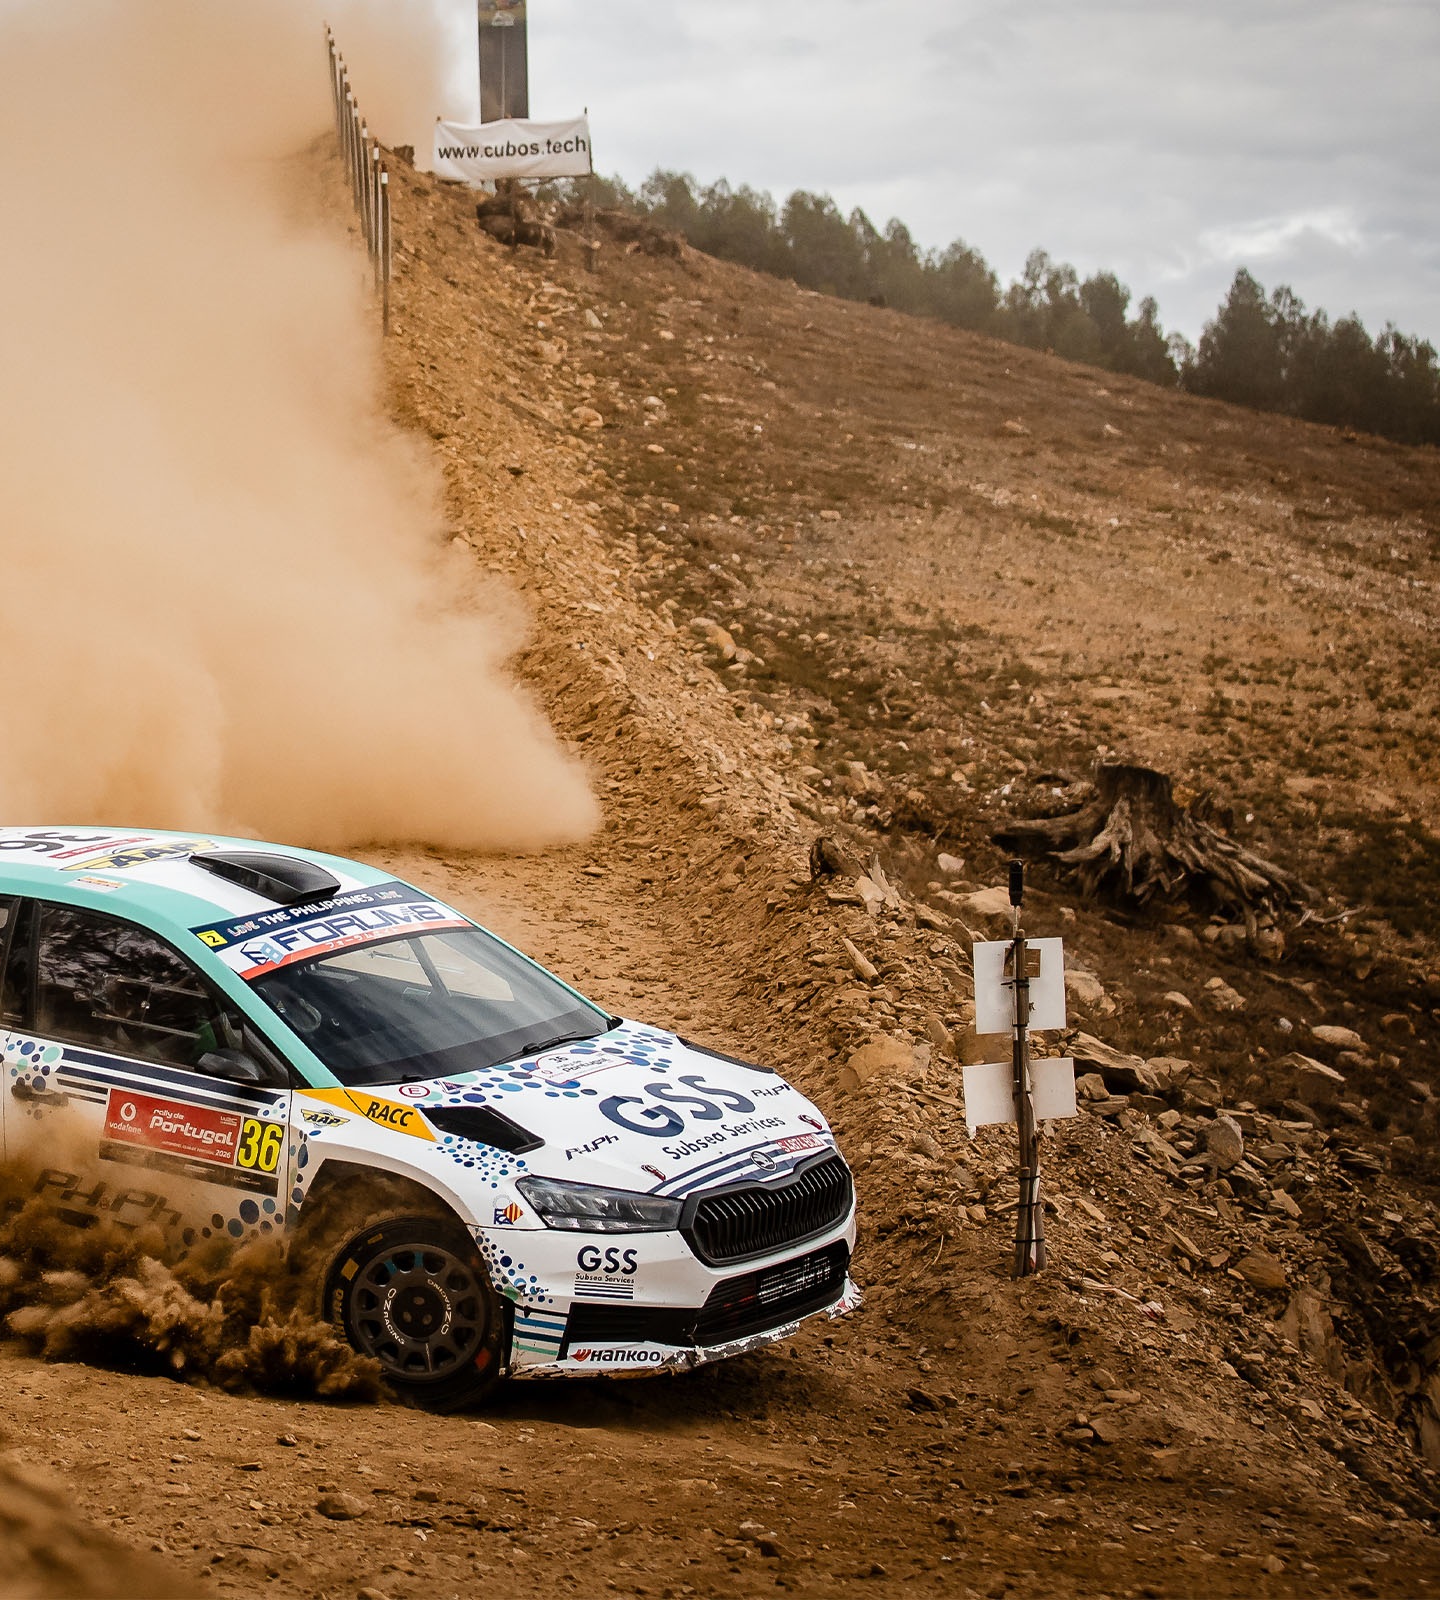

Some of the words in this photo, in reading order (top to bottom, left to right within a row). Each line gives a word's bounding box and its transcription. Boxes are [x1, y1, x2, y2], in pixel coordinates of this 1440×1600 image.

[438, 136, 586, 159] www.cubos.tech
[260, 910, 291, 926] THE
[289, 893, 376, 918] PHILIPPINES
[270, 905, 447, 951] FORUM8
[153, 1108, 174, 1119] rally
[174, 1112, 185, 1120] de
[306, 1113, 342, 1125] AAP
[366, 1101, 414, 1127] RACC
[599, 1075, 755, 1138] GSS
[109, 1122, 142, 1135] vodafone
[149, 1115, 234, 1146] Portugal
[662, 1130, 728, 1160] Subsea
[721, 1115, 786, 1137] Services
[215, 1149, 231, 1159] 2026
[238, 1119, 283, 1172] 36
[577, 1245, 638, 1275] GSS
[575, 1273, 602, 1282] Subsea
[605, 1275, 635, 1284] Services
